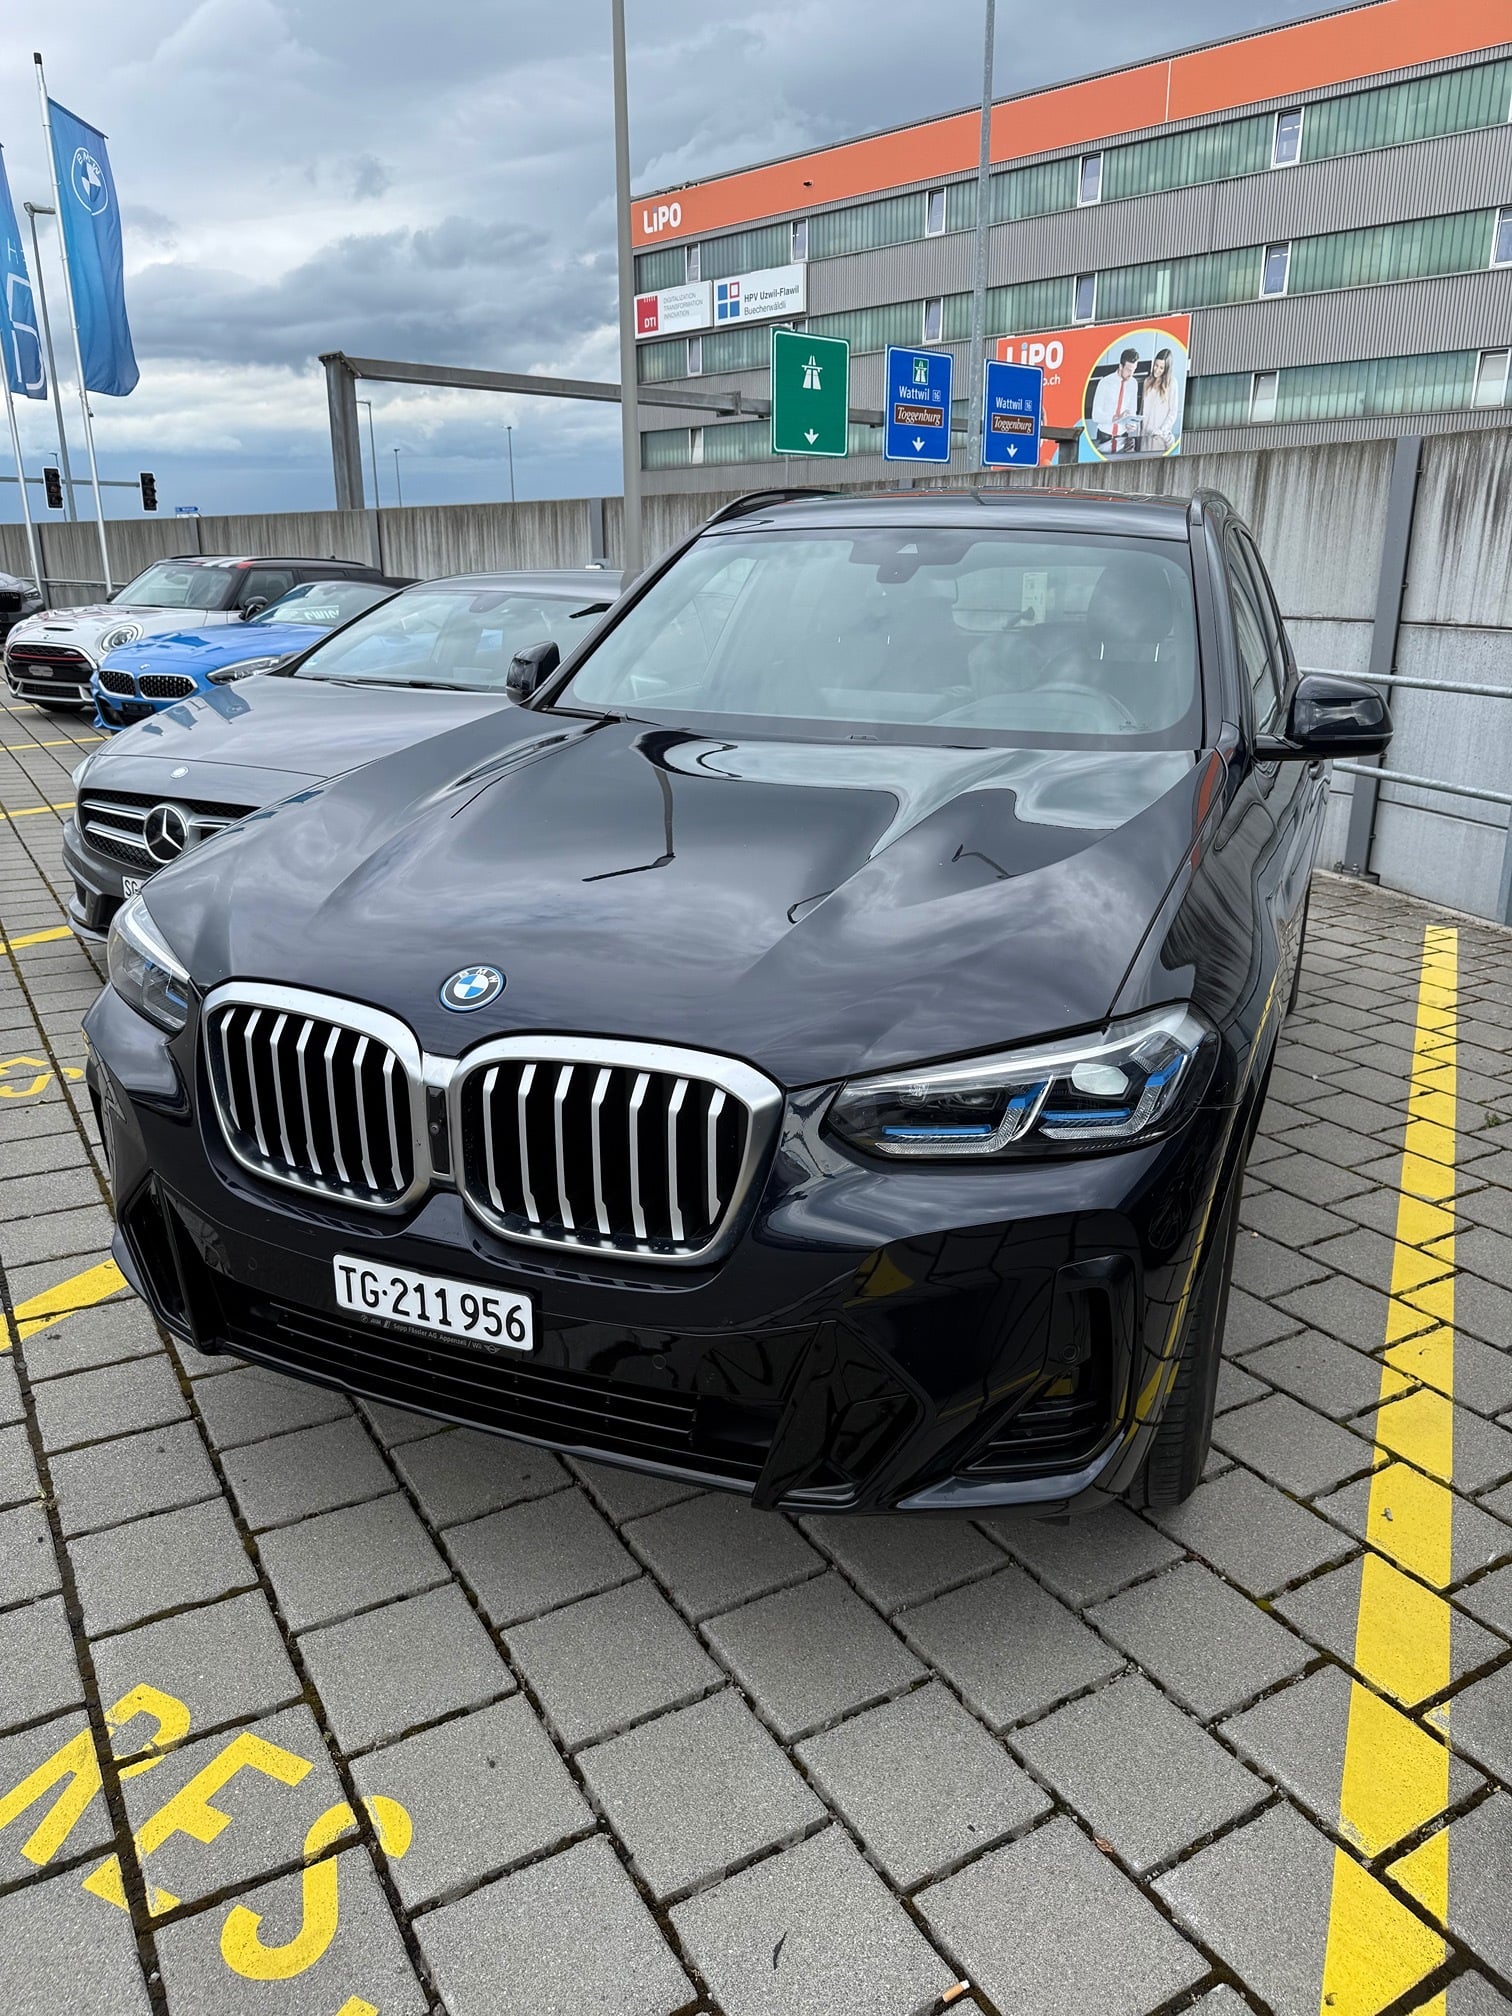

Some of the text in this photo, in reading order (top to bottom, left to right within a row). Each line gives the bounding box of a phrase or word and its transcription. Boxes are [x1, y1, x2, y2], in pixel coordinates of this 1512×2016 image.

[744, 284, 799, 303] HPV Uzwil-Flawil
[664, 299, 703, 311] TRANSFORMATION
[644, 317, 656, 328] DTI
[898, 385, 930, 401] Wattwil
[995, 396, 1023, 411] Wattwil
[897, 406, 941, 426] Toggenburg
[994, 416, 1032, 433] Toggenburg
